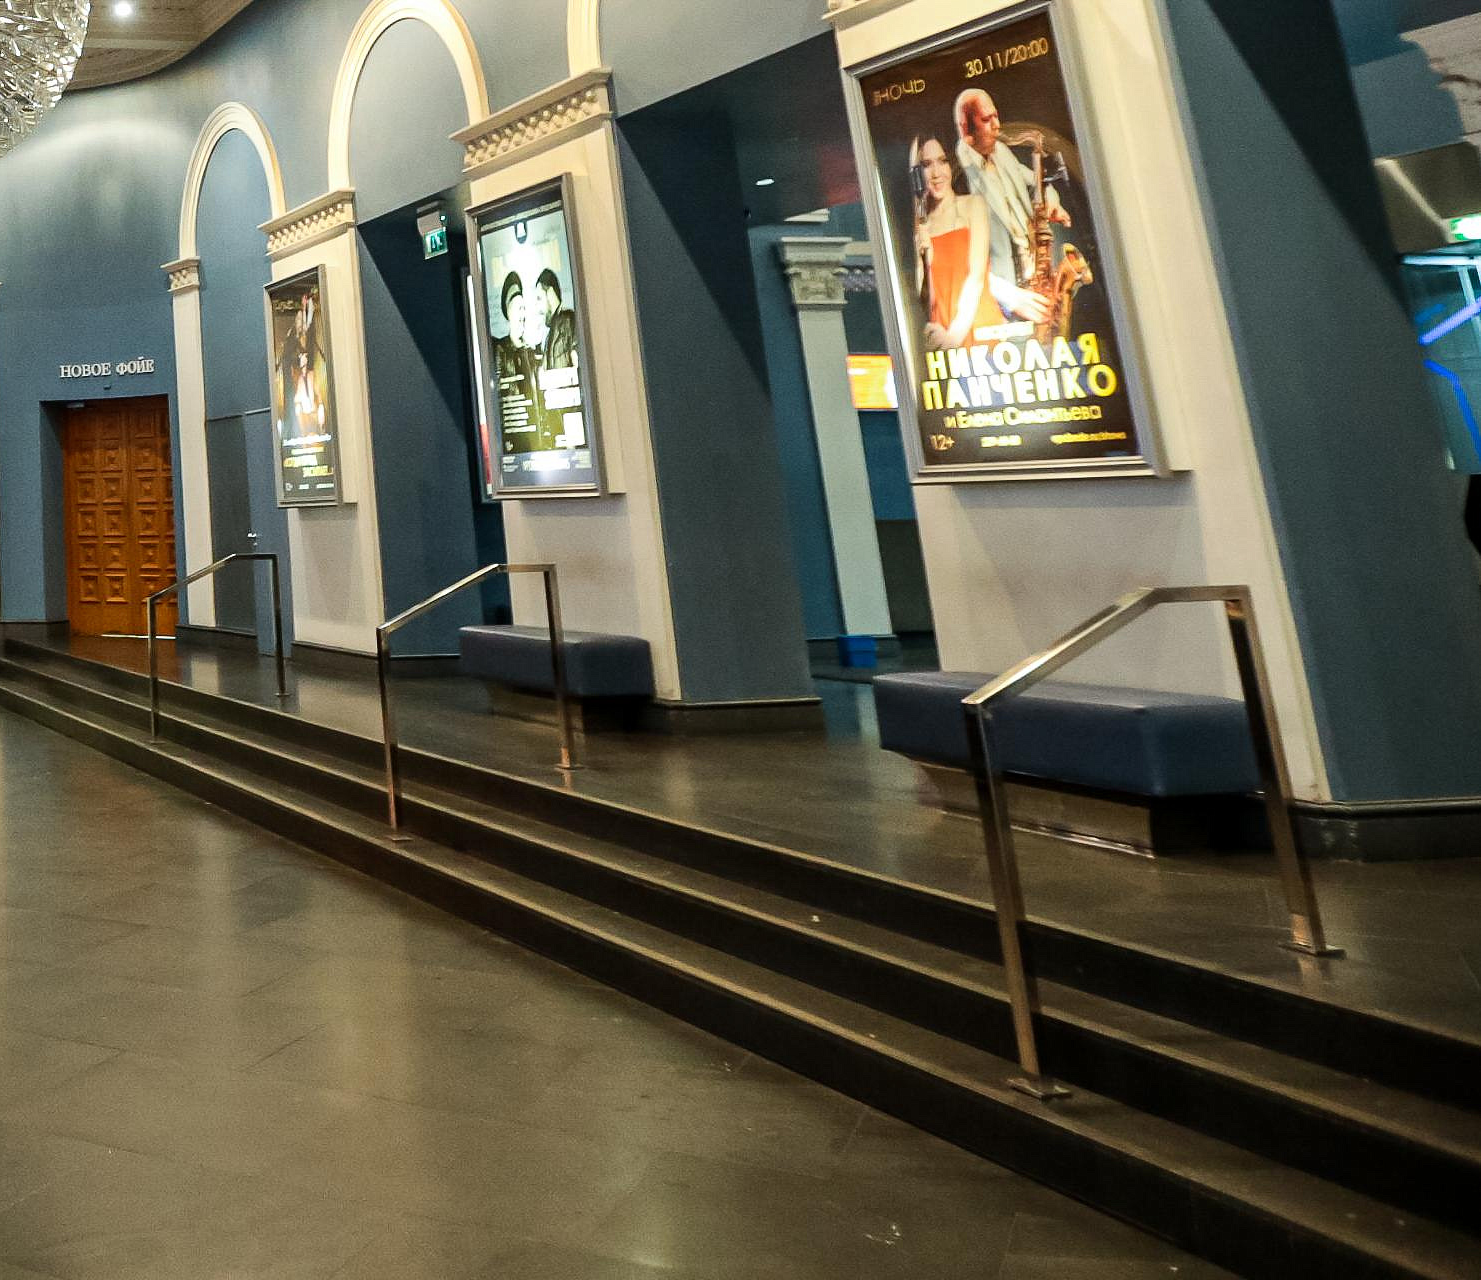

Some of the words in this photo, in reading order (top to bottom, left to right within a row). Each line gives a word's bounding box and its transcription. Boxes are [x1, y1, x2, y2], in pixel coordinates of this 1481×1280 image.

[965, 37, 1049, 78] 30.11/20:00
[59, 362, 112, 378] НОВОЕ
[116, 356, 155, 376] ФОЙЕ
[926, 333, 1101, 380] НИКОЛАЯ
[922, 364, 1117, 411] ПАНЧЕНКО
[930, 433, 955, 451] 12+
